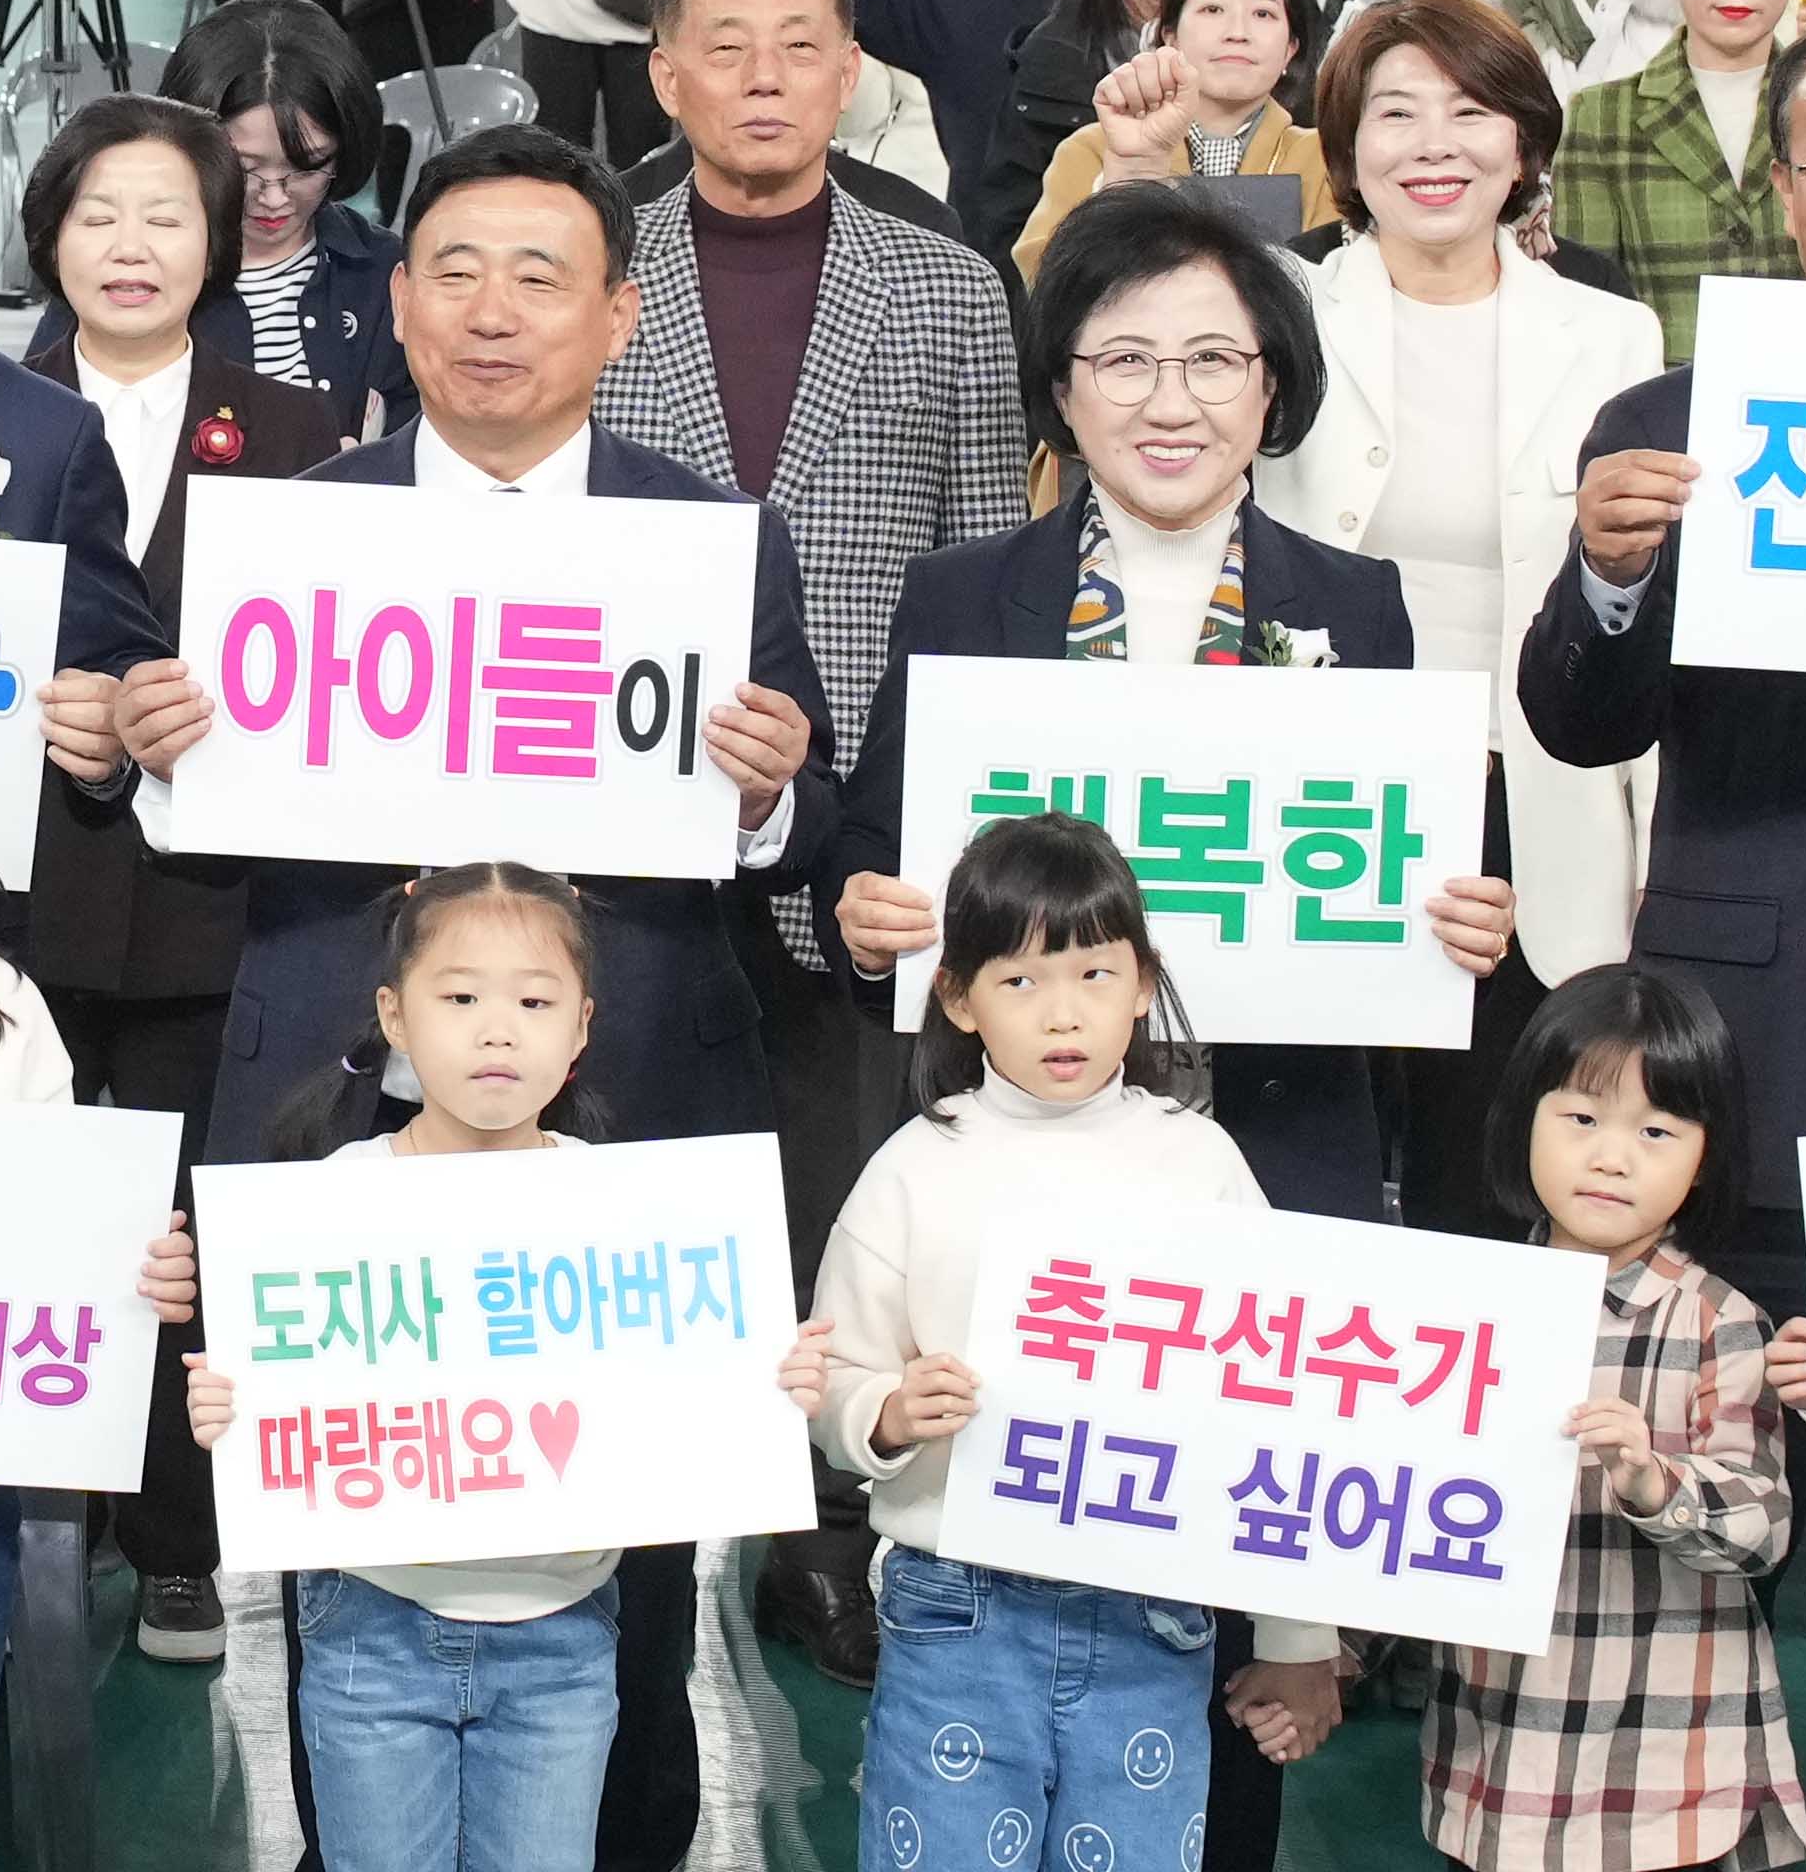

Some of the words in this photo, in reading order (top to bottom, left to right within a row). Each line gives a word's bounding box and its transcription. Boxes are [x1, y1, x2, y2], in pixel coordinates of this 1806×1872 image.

[220, 588, 701, 780] 아이들이
[253, 1260, 445, 1362] 도지사
[474, 1236, 746, 1358] 할아버지
[1014, 1257, 1502, 1438] 축구선수가
[993, 1418, 1178, 1532] 되고
[1229, 1448, 1504, 1581] 싶어요
